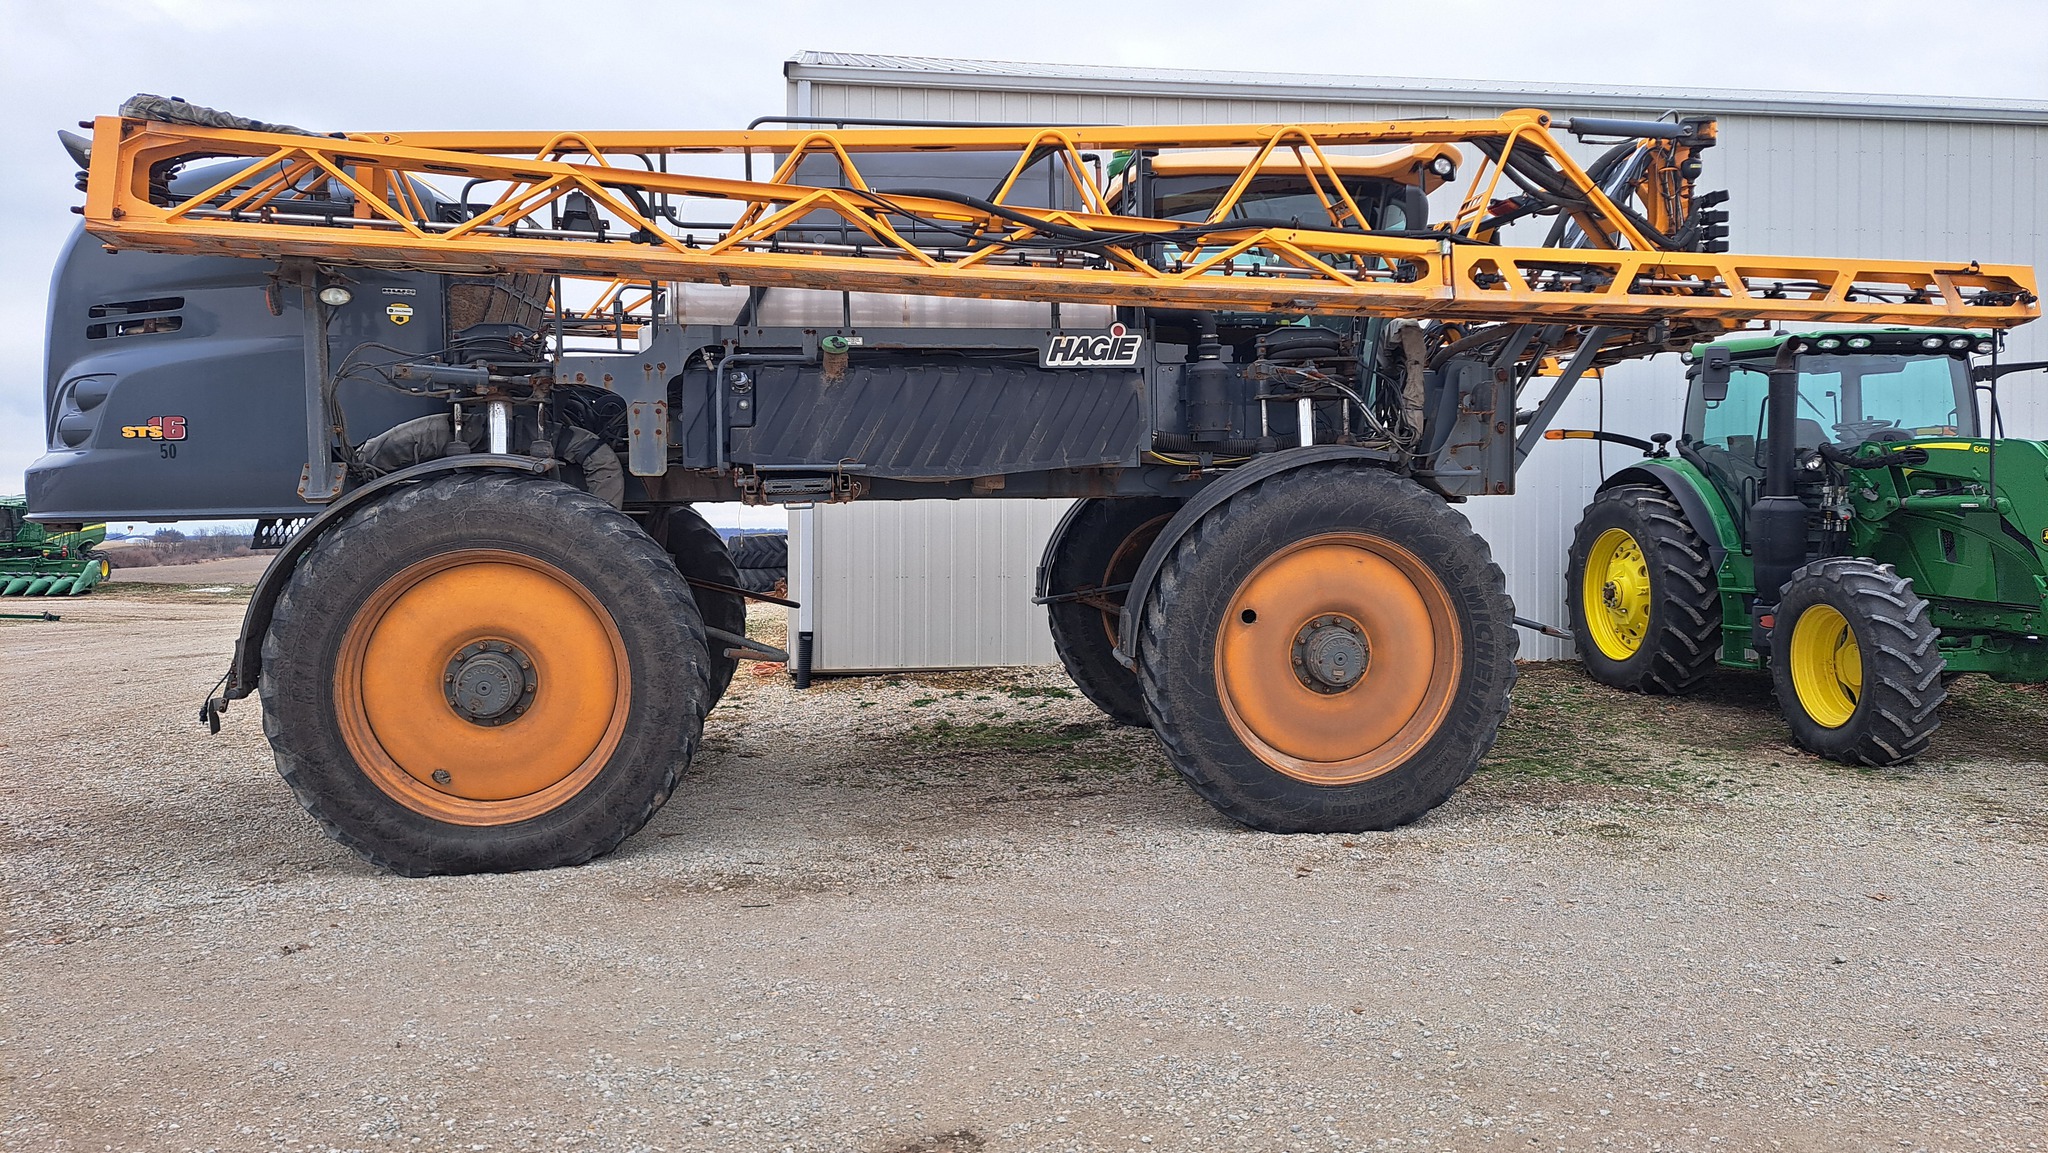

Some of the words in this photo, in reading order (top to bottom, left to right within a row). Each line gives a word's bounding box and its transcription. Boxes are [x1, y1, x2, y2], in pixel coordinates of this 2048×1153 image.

[1046, 323, 1142, 366] HAGIE
[121, 426, 163, 438] STS
[147, 416, 186, 440] 16
[160, 443, 176, 459] 50
[1457, 585, 1496, 742] MICHELIN
